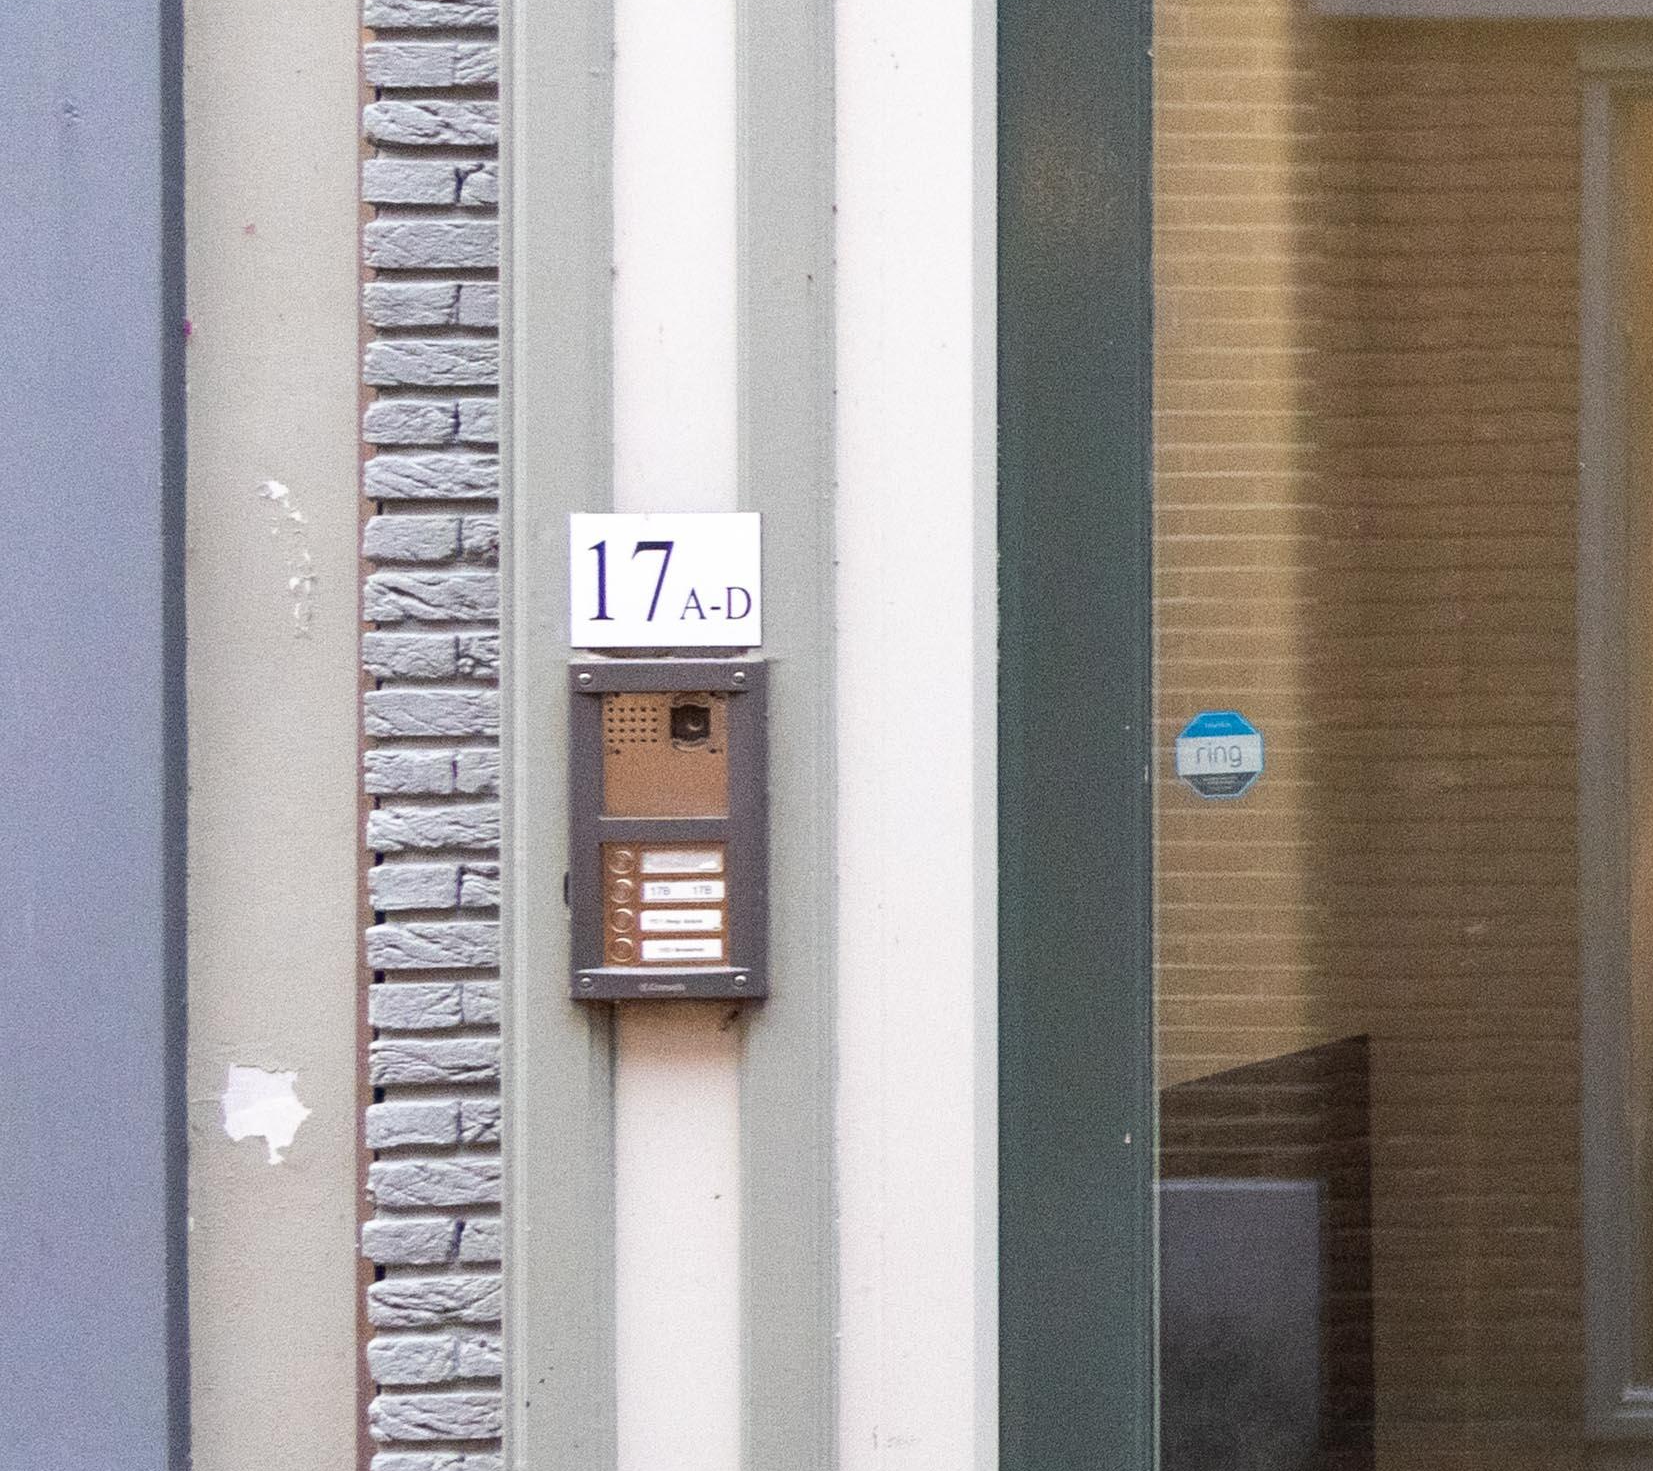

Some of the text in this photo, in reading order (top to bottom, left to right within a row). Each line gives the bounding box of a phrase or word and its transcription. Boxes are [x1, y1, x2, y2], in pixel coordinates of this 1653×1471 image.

[587, 539, 752, 622] 17 A-D
[1196, 742, 1242, 768] ring
